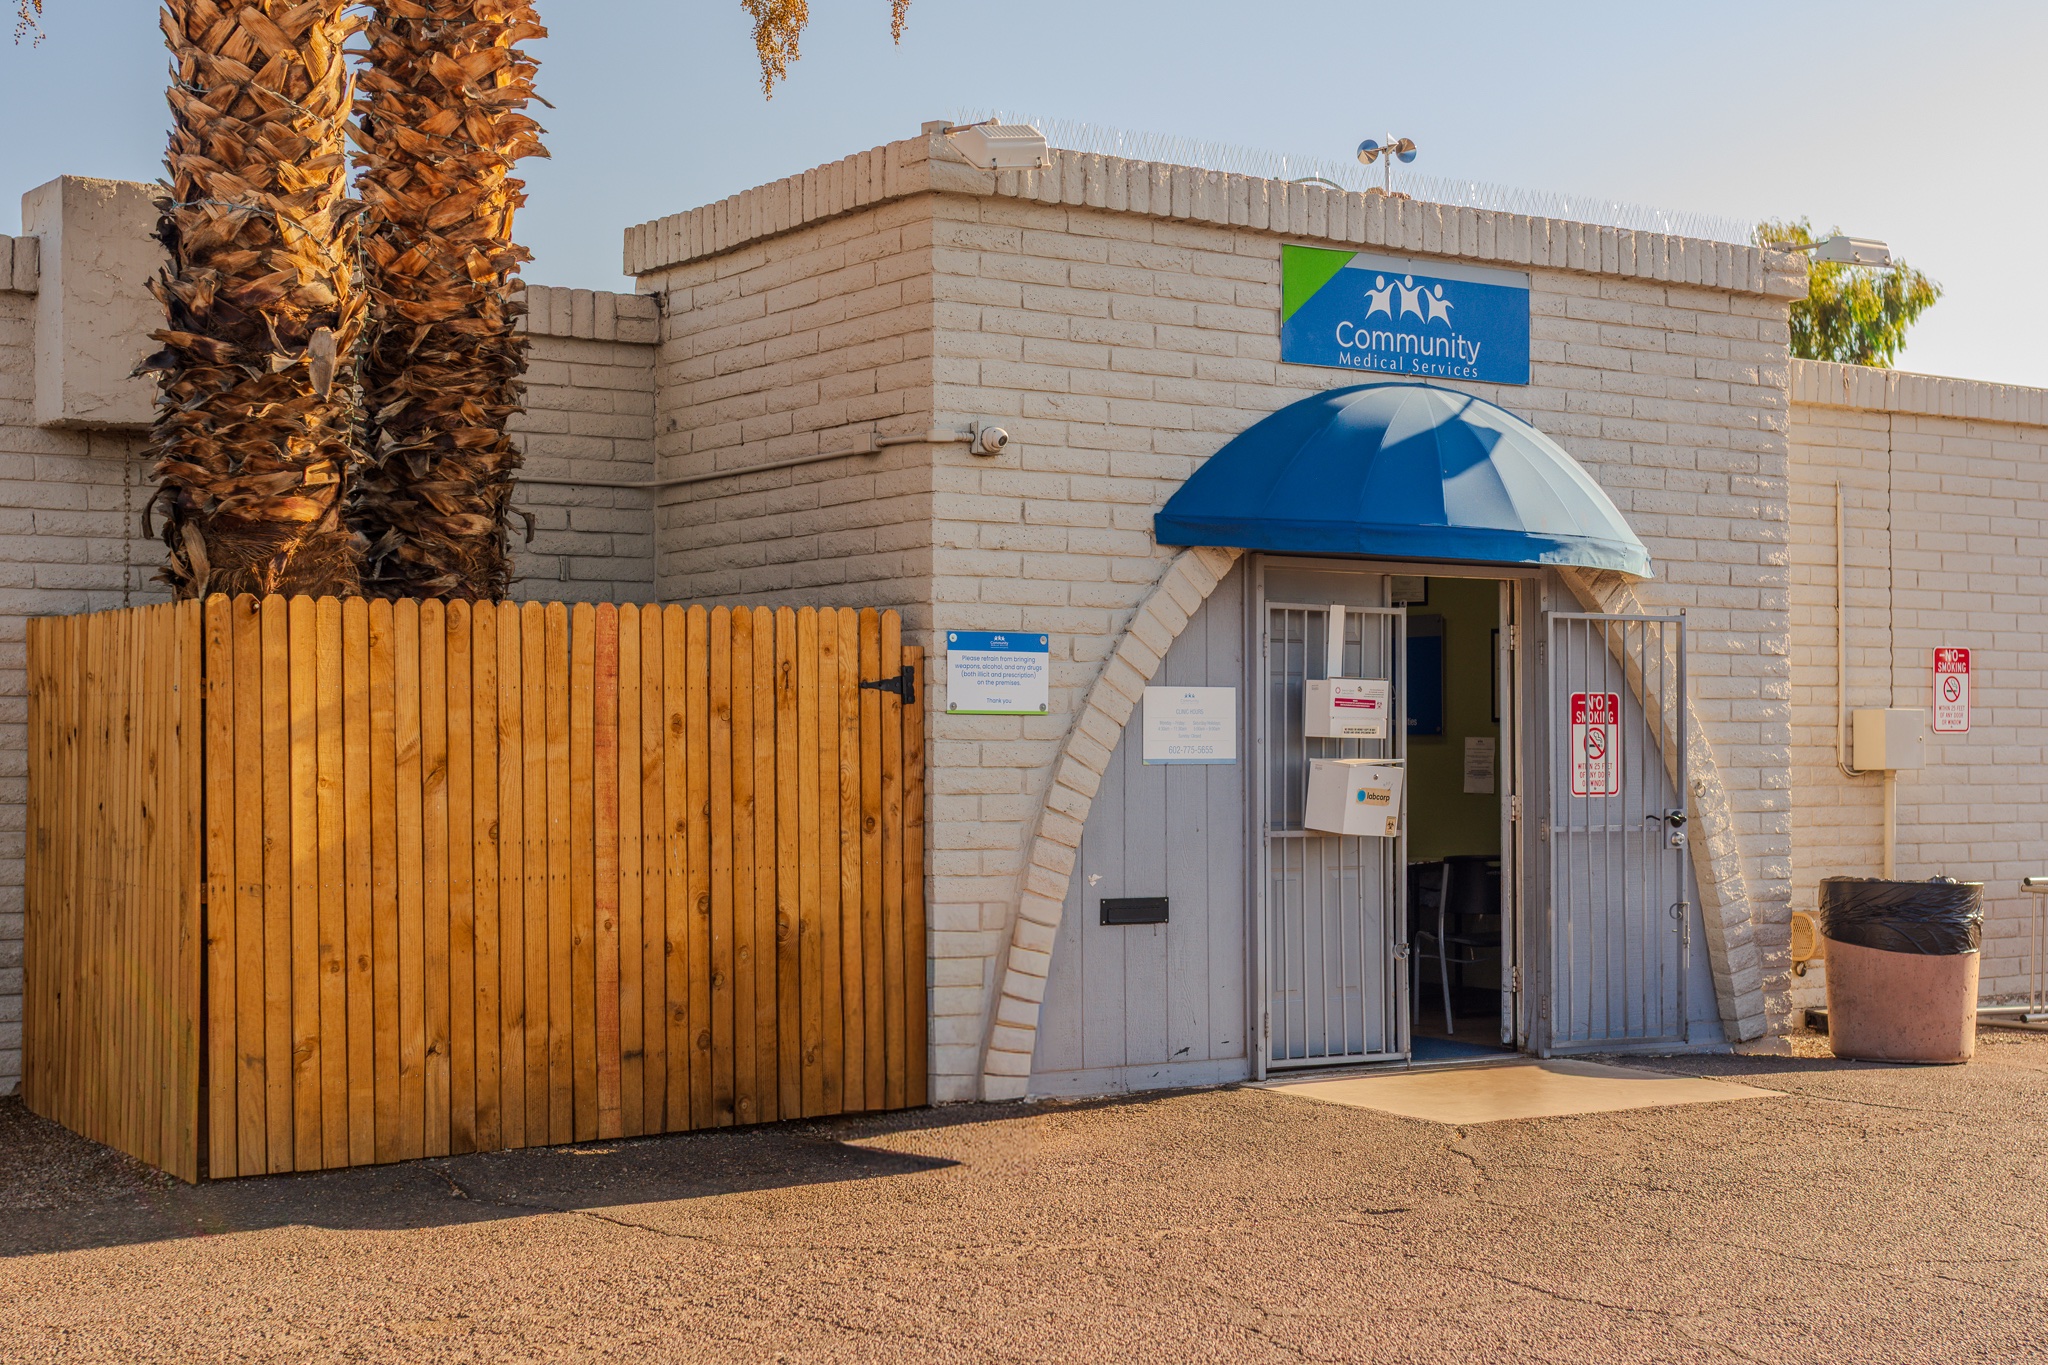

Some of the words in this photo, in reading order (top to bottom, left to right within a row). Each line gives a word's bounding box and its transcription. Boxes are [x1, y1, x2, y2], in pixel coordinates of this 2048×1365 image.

[1336, 321, 1481, 365] Community
[1339, 351, 1403, 370] Medical
[1412, 358, 1478, 378] Services
[1938, 662, 1966, 673] SMOKING
[1168, 746, 1213, 754] 602-775-5655
[1367, 792, 1390, 802] labcorp
